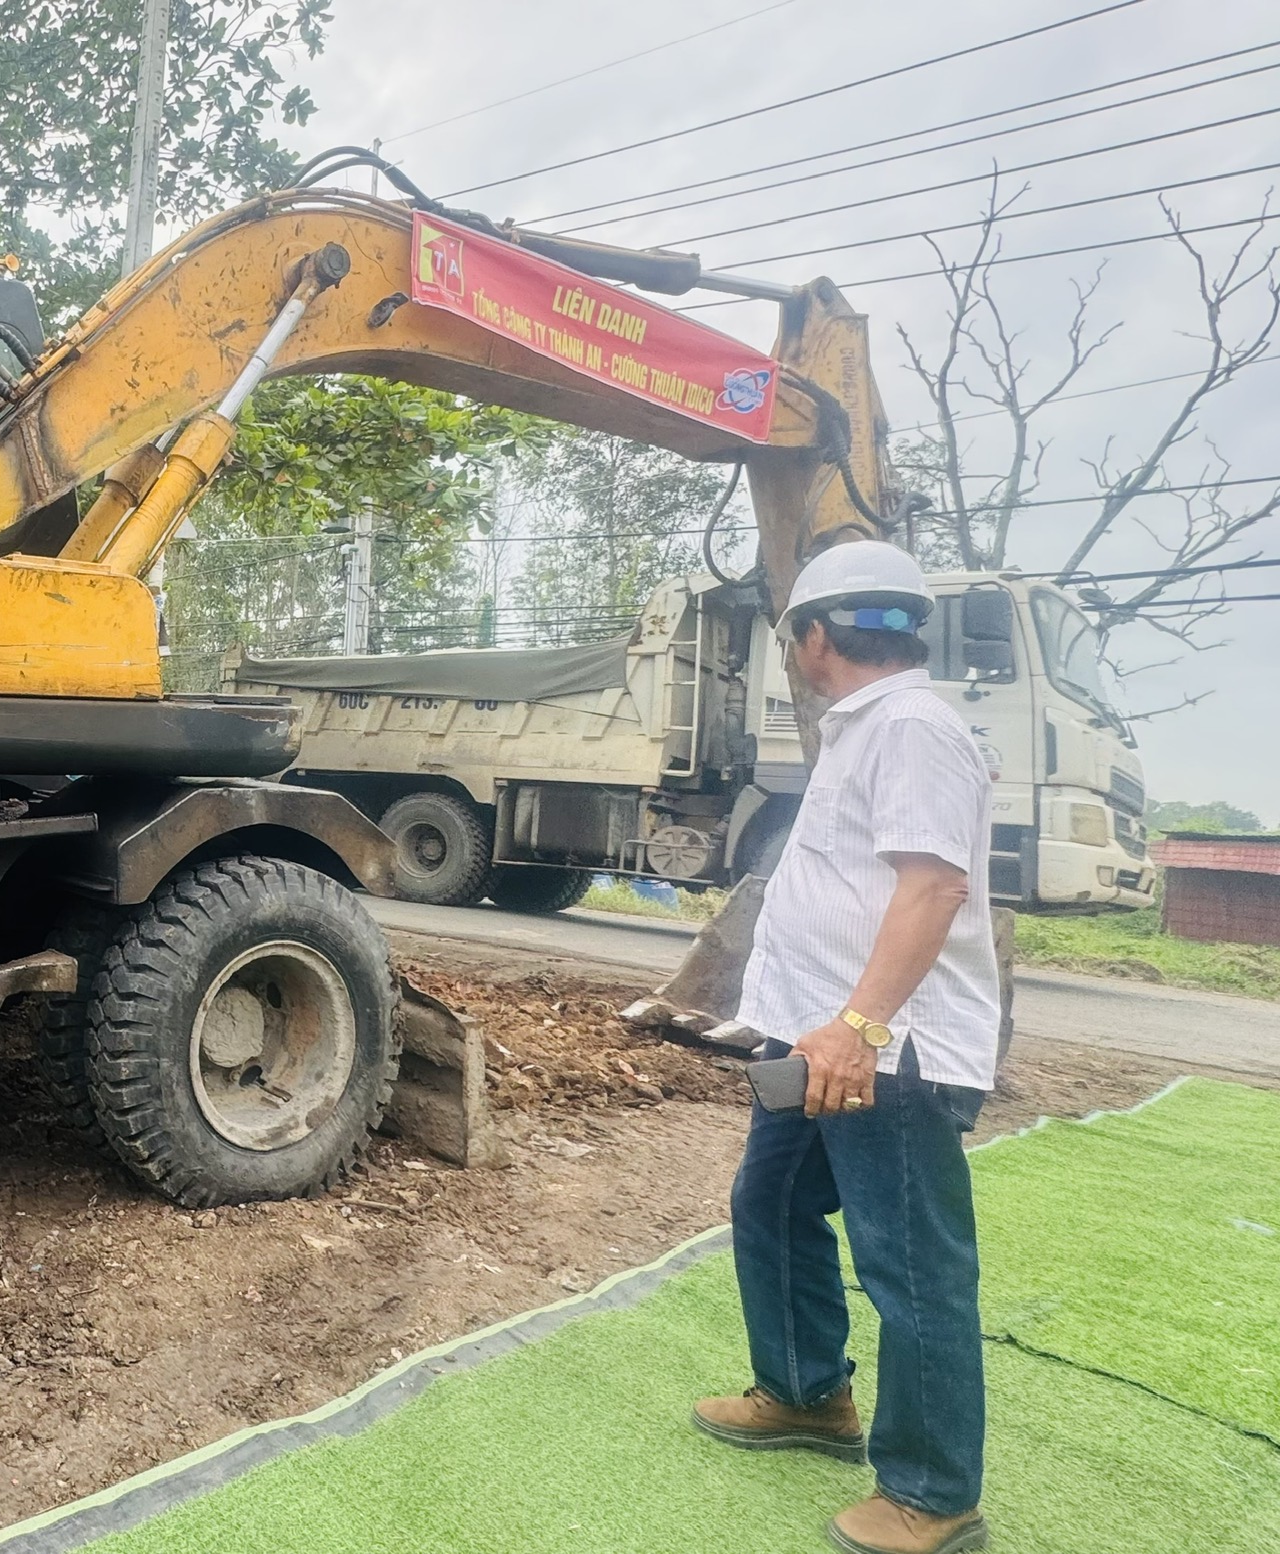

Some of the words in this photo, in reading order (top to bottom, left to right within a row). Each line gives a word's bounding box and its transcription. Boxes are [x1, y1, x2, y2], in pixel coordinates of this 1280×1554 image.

[551, 285, 596, 326] LIÊN
[596, 302, 648, 345] DANH
[533, 321, 547, 348] TY
[548, 328, 584, 366] THÀNH
[586, 343, 602, 373] AN
[611, 353, 648, 390] CƯỜNG
[684, 381, 715, 416] IDICO
